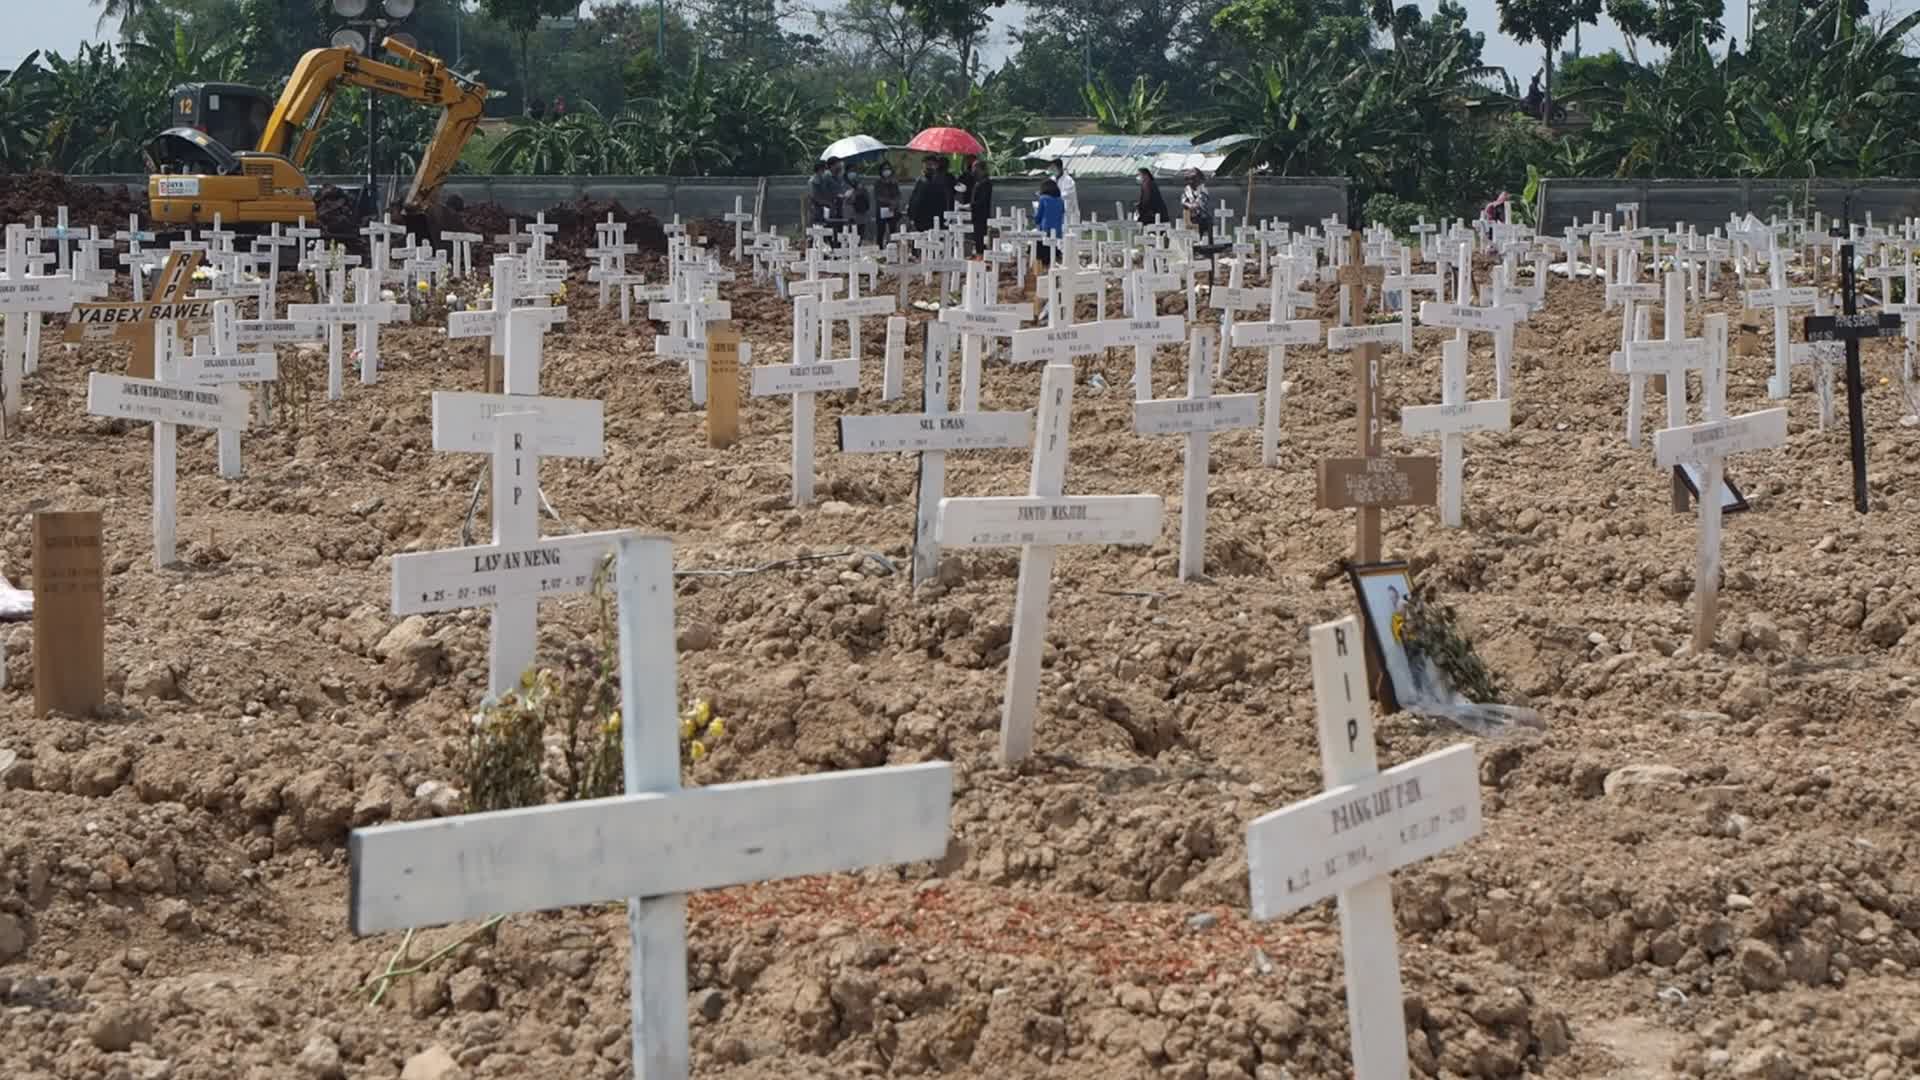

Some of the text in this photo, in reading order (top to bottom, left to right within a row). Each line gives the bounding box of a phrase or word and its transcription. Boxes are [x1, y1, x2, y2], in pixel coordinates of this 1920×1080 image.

[179, 98, 193, 114] 12
[163, 253, 191, 299] RIP
[78, 303, 214, 324] YABEX BAWEL
[1048, 388, 1064, 451] RIP
[1368, 360, 1380, 448] RIP
[513, 432, 524, 506] RIP
[523, 547, 561, 568] NENG
[1334, 626, 1359, 753] RIP
